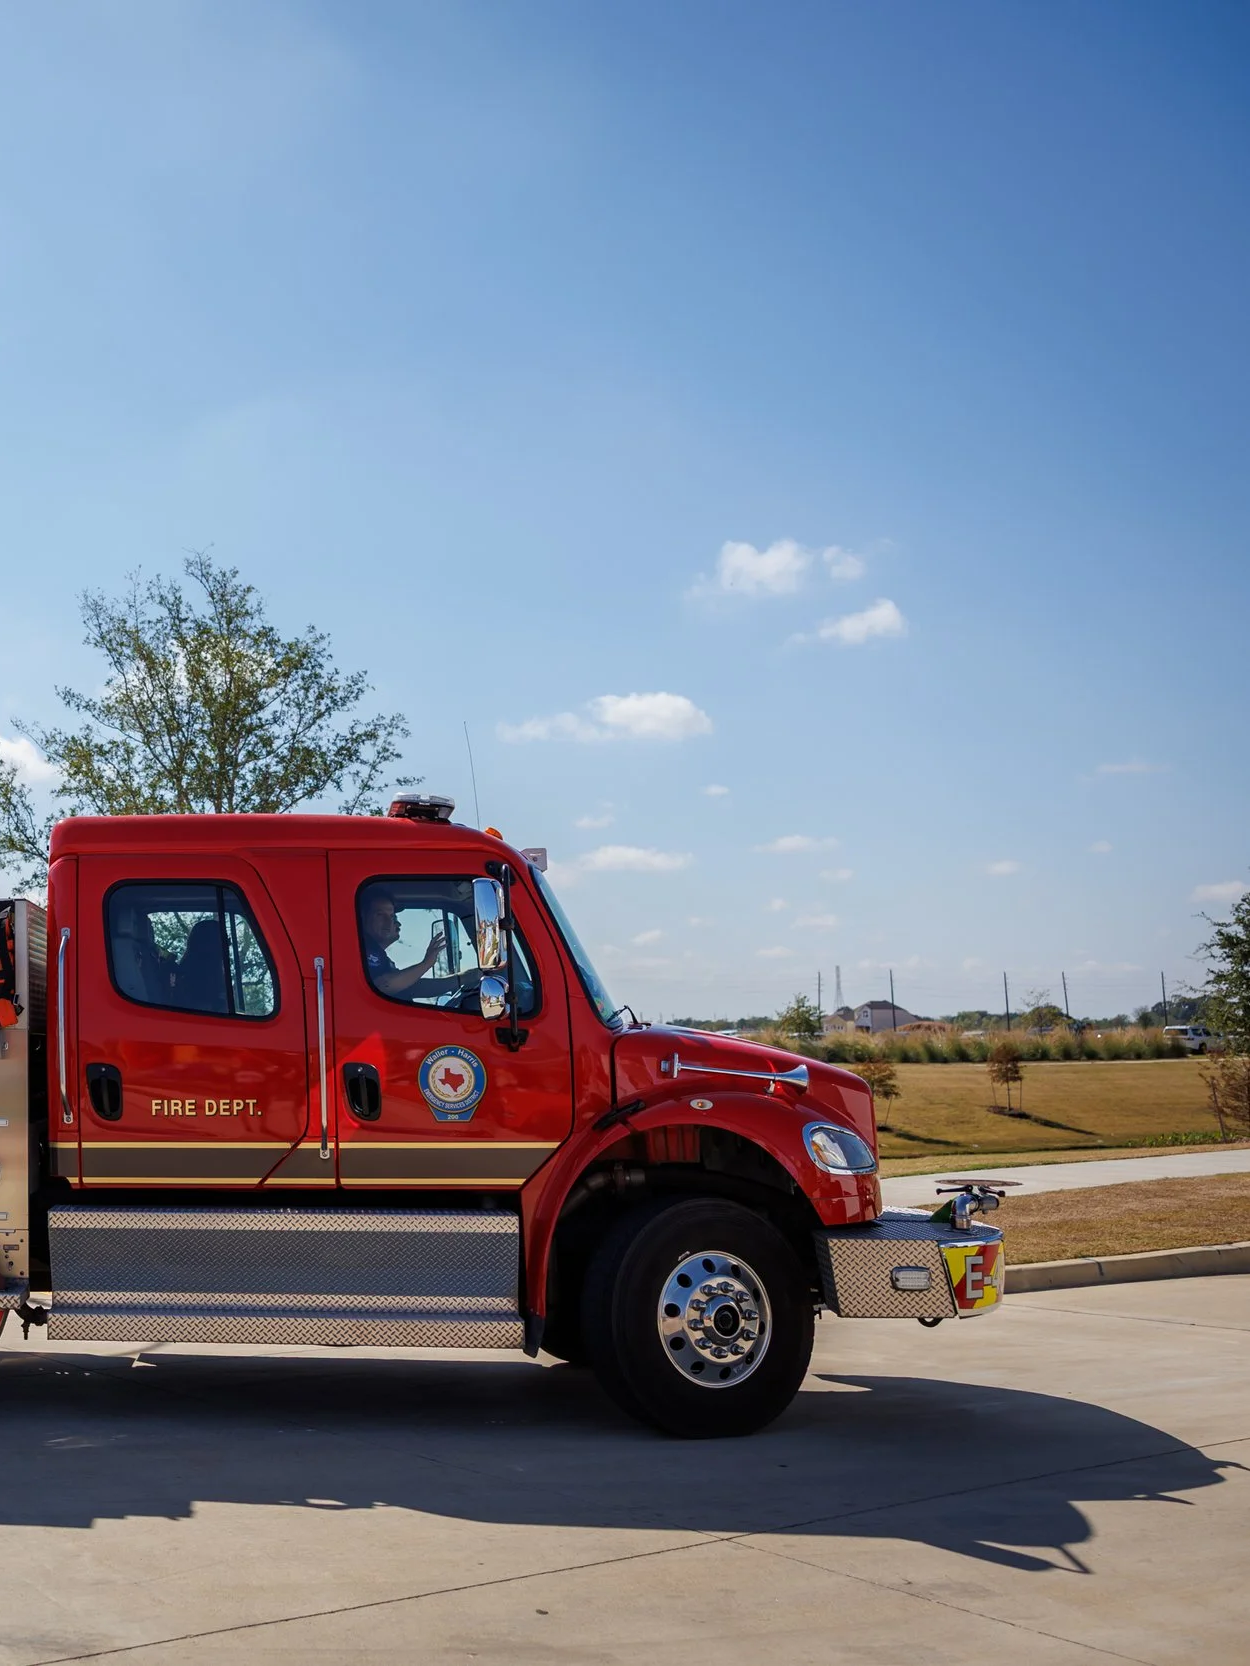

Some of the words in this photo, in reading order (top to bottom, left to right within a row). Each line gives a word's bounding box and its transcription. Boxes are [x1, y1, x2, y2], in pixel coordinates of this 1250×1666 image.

[425, 1049, 448, 1066] Waller
[457, 1048, 479, 1068] Harris
[151, 1099, 197, 1116] FIRE
[205, 1099, 262, 1116] DEPT.
